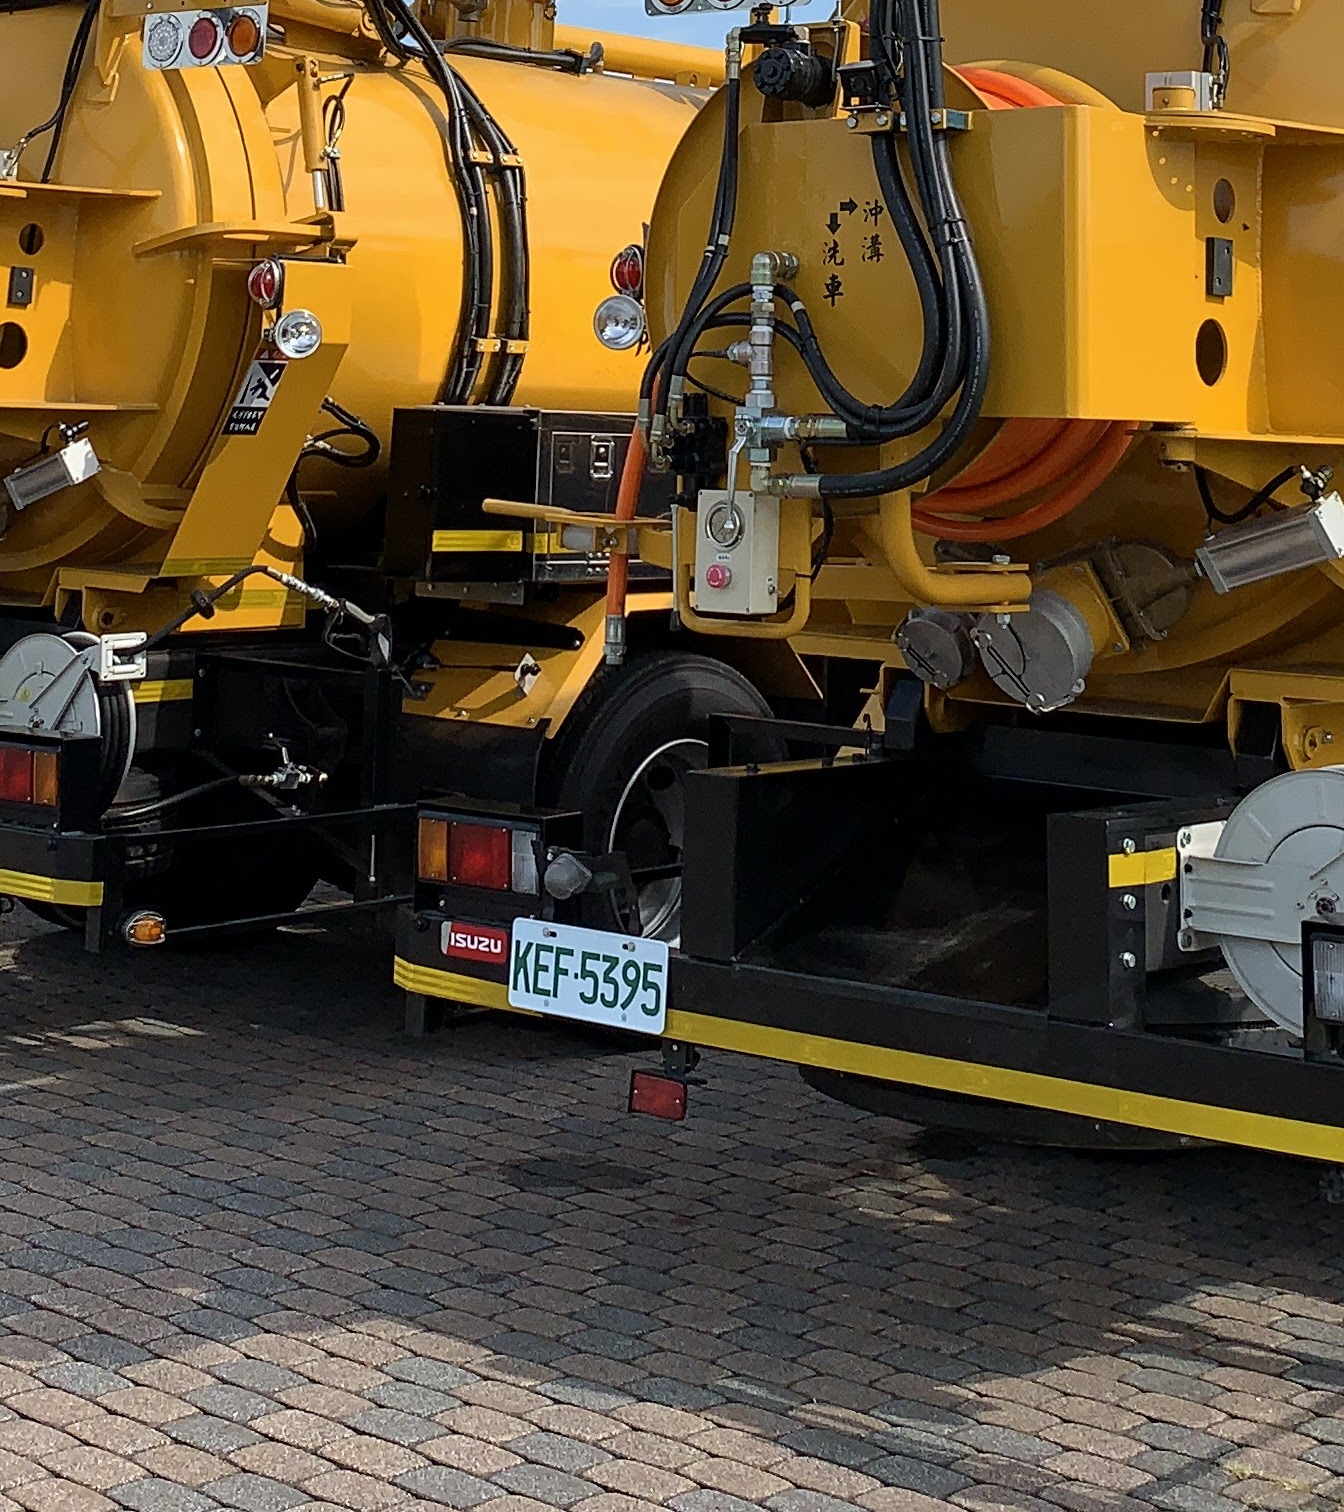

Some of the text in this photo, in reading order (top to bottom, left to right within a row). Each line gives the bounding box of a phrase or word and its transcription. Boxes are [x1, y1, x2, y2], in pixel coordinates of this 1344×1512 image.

[822, 238, 845, 308] 洗車
[450, 931, 503, 955] ISUZU
[512, 940, 663, 1018] KEF-5395
